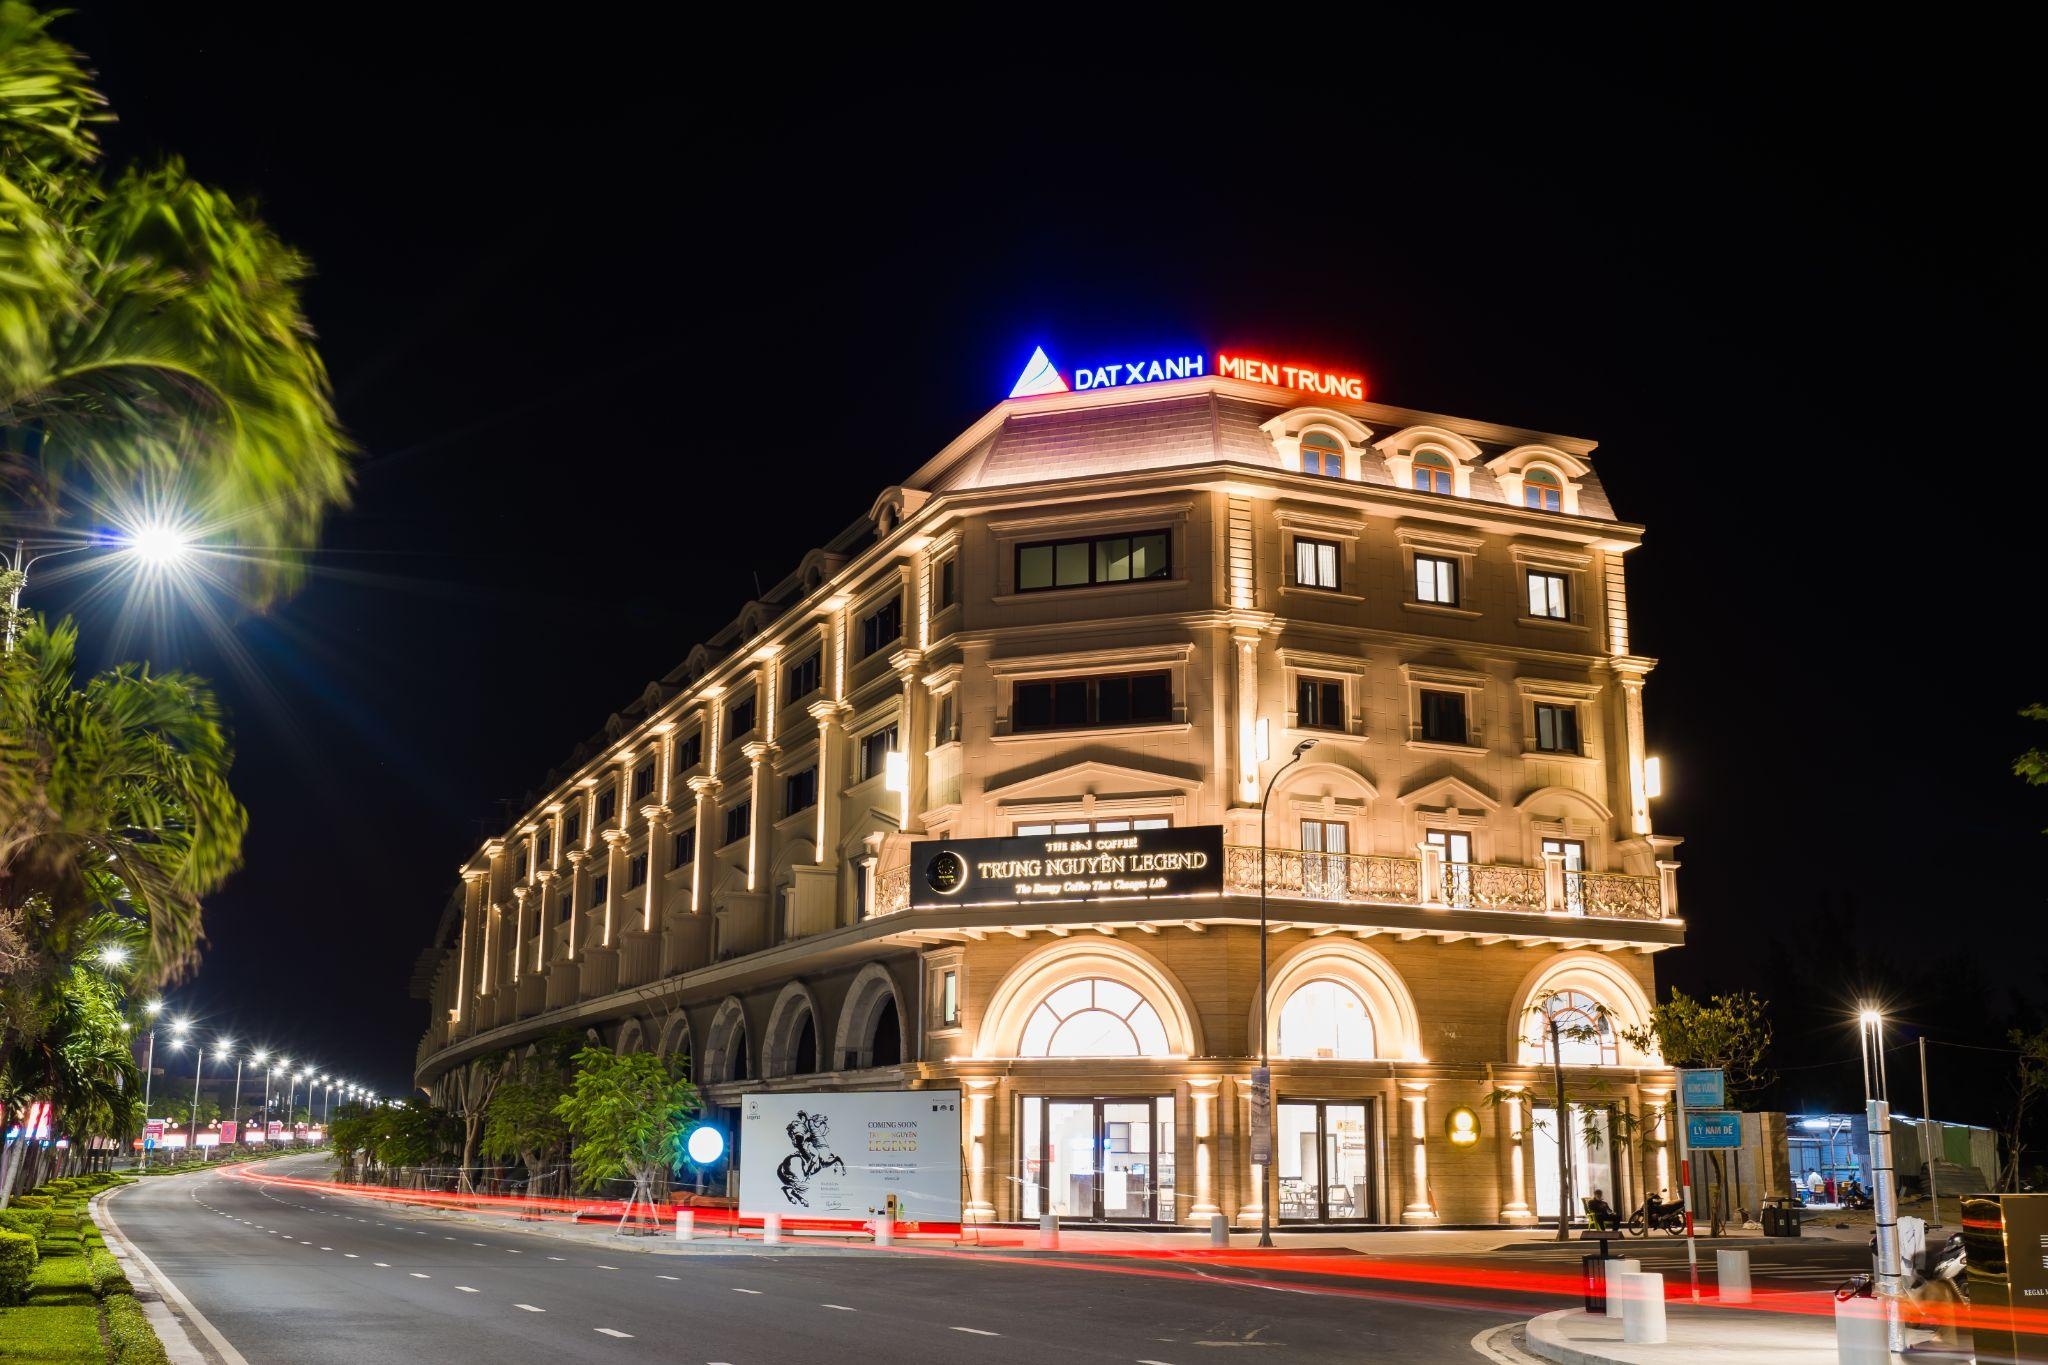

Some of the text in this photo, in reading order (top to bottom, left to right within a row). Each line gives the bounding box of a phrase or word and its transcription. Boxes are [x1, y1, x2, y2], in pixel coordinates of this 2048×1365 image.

[1075, 355, 1203, 390] DAT XANH
[1219, 354, 1363, 400] MIEN TRUNG
[1045, 842, 1068, 852] THE
[978, 852, 1207, 878] TRUNG NGUYÊN LEGEND
[868, 1140, 918, 1152] LEGEND
[2024, 1288, 2044, 1296] REGAL
